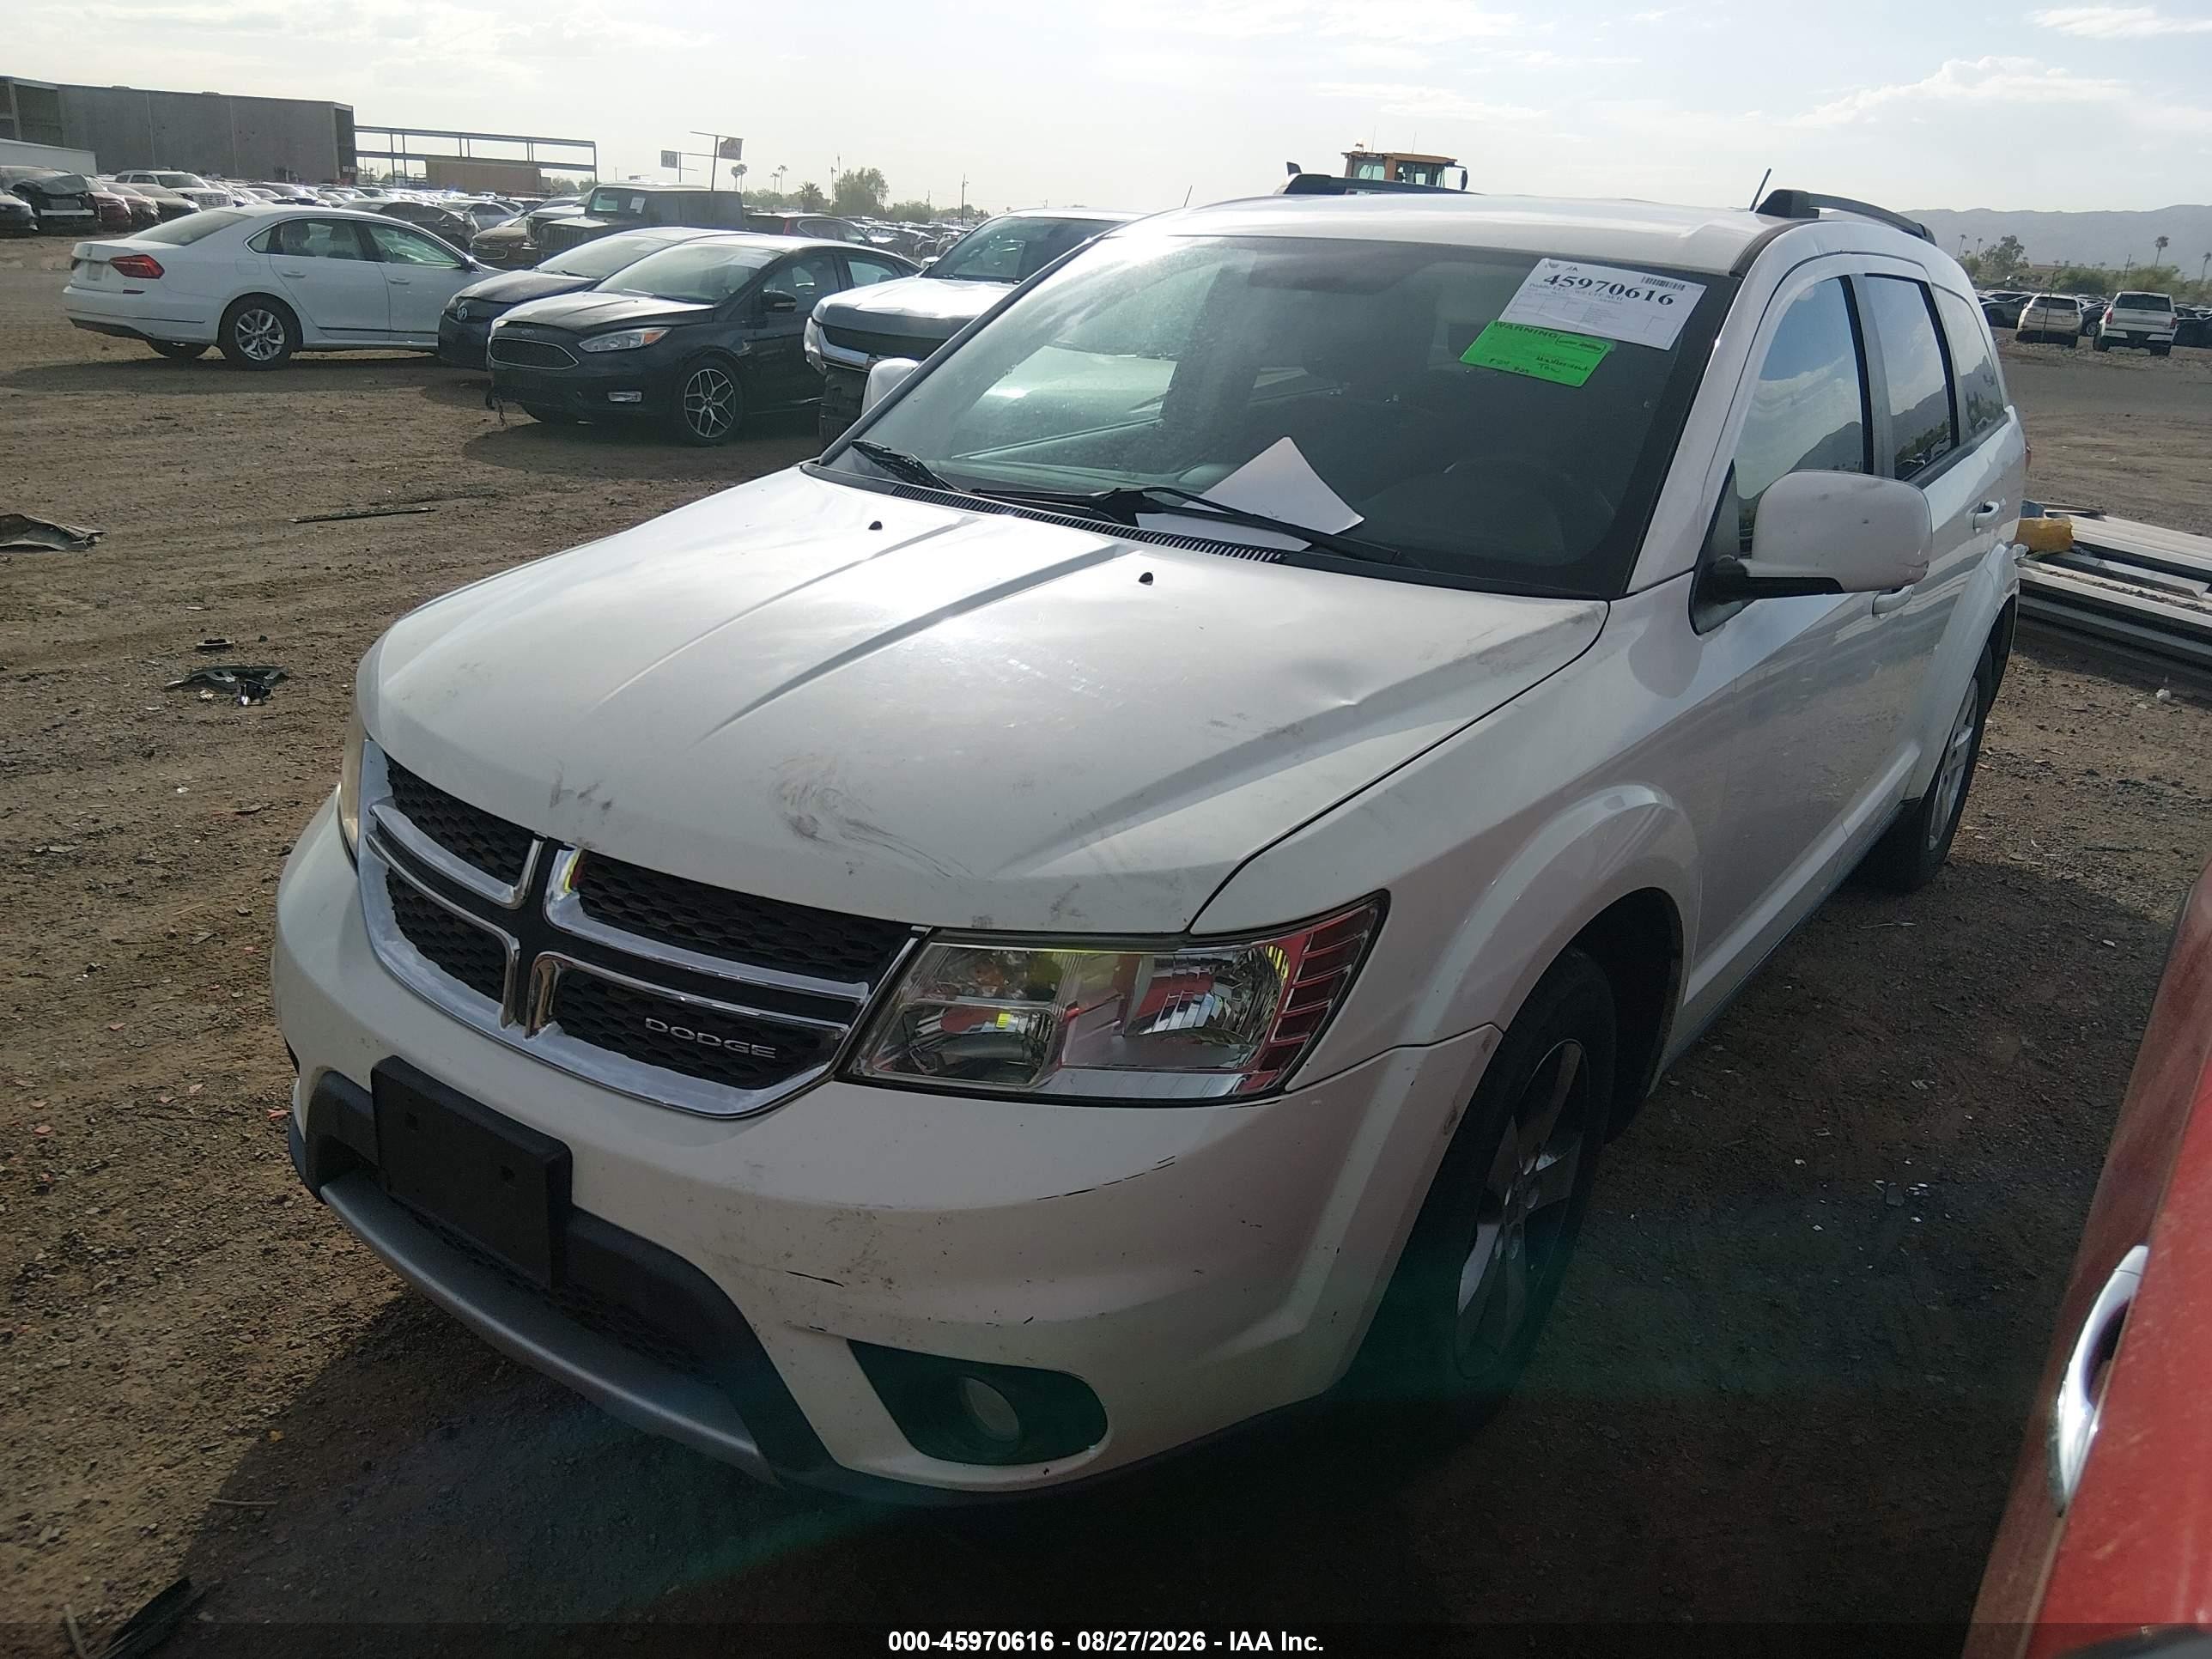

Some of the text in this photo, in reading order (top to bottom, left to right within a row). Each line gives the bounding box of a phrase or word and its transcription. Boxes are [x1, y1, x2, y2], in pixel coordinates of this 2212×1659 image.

[1543, 274, 1677, 306] 45970616
[1494, 321, 1558, 339] WARNING
[645, 1017, 777, 1059] DODGE
